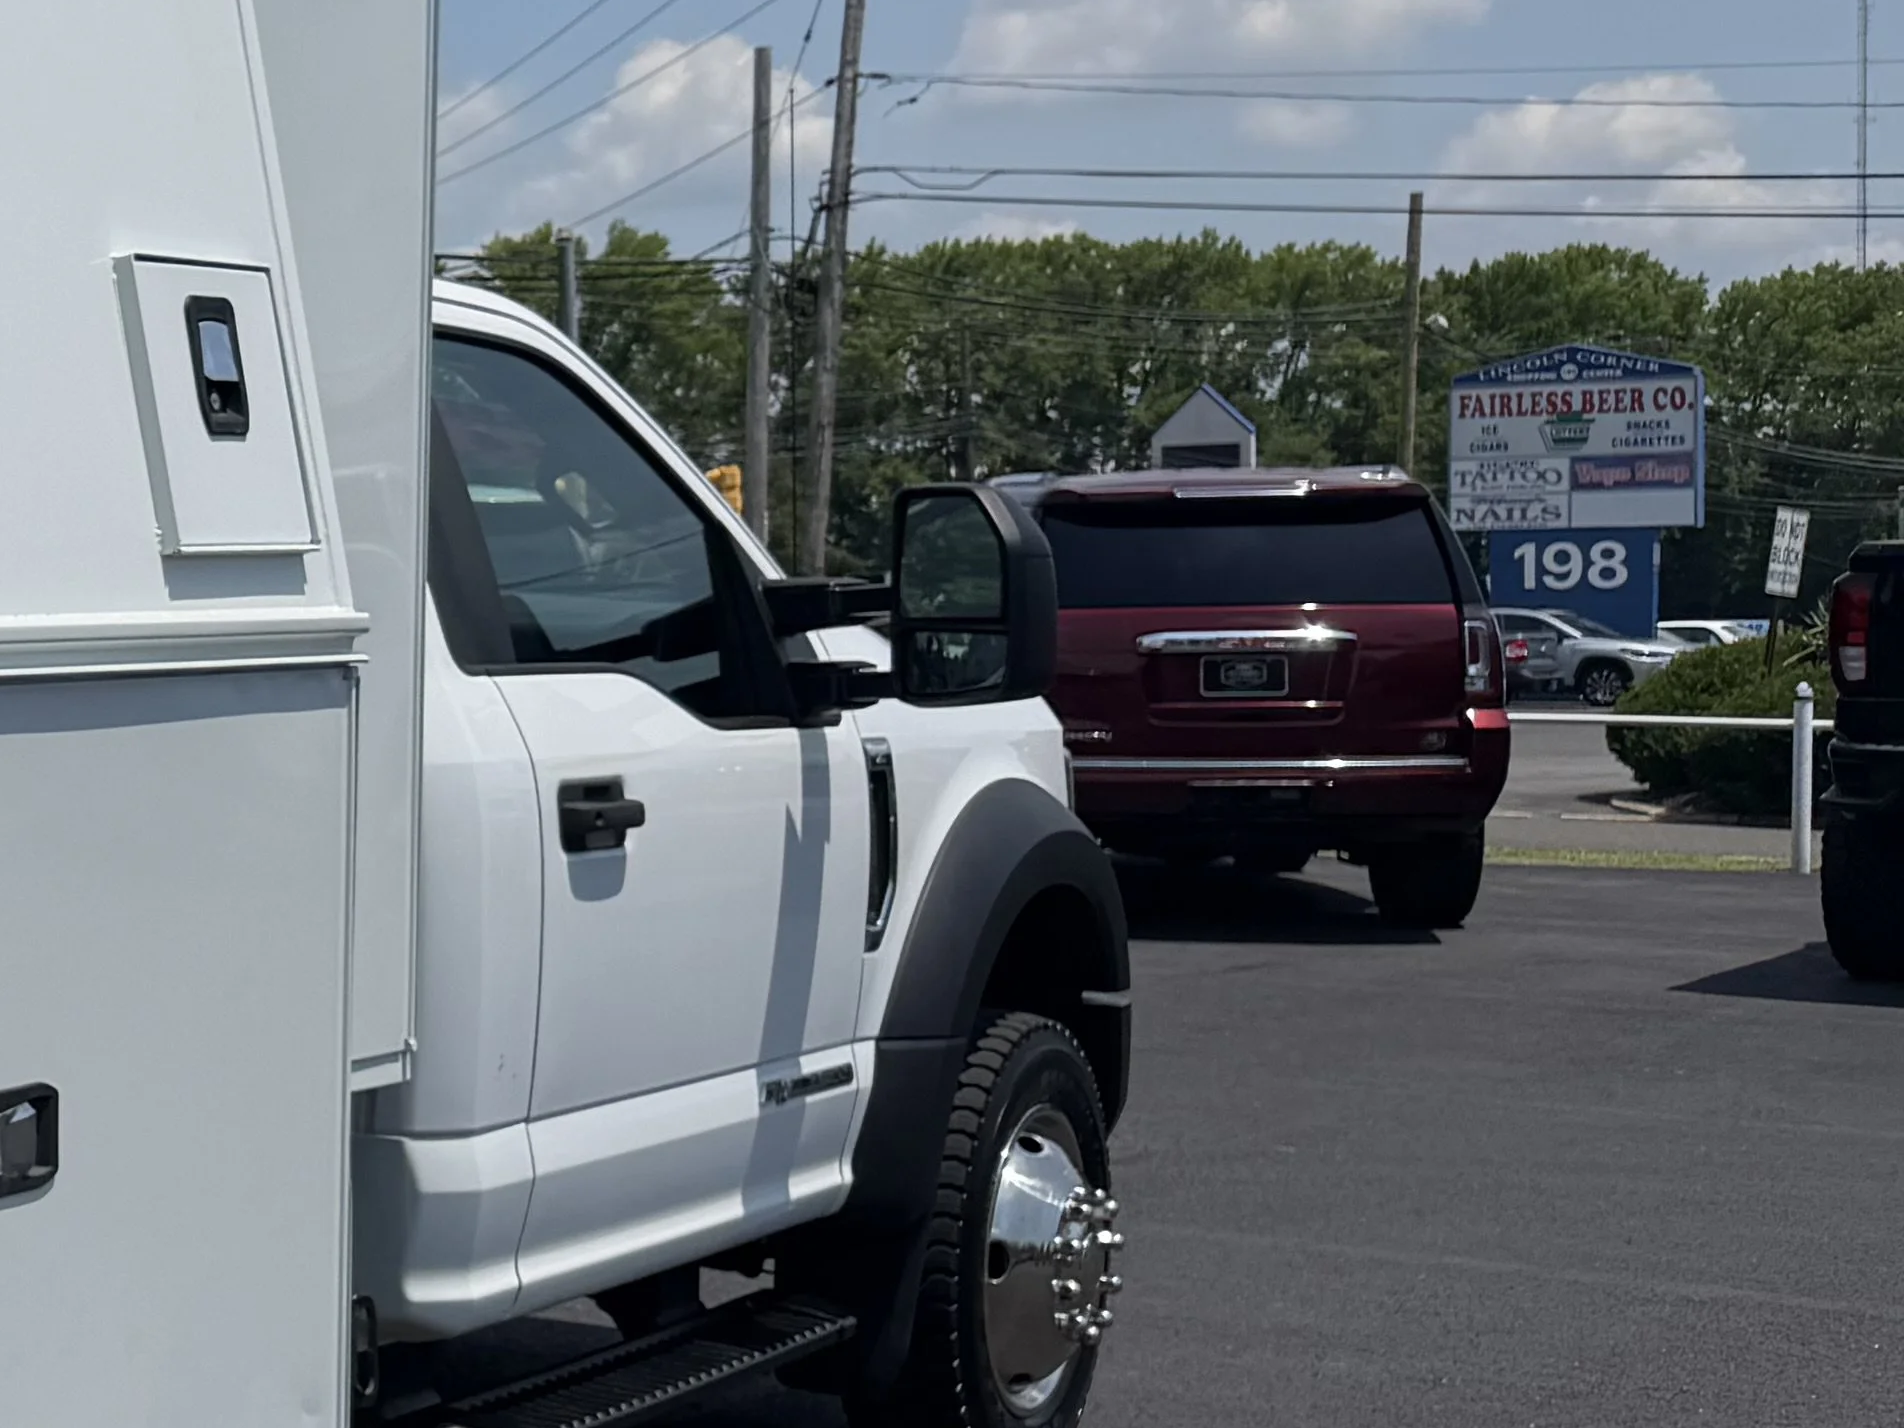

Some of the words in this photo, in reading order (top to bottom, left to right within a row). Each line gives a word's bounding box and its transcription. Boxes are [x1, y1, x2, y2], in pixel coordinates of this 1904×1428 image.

[1479, 351, 1568, 382] LINCOLN
[1576, 352, 1660, 373] CORNER
[1458, 391, 1573, 419] FAIRLESS
[1581, 387, 1645, 414] BEER
[1653, 386, 1694, 412] CO.
[1481, 424, 1498, 436] ICE
[1626, 419, 1670, 432] SNACKS
[1469, 440, 1509, 453] CIGARS
[1612, 435, 1686, 449] CIGARETTES
[1454, 468, 1562, 490] TATTOO
[1455, 505, 1562, 523] NAILS
[1513, 539, 1629, 591] 198
[1771, 544, 1801, 566] BLOCK
